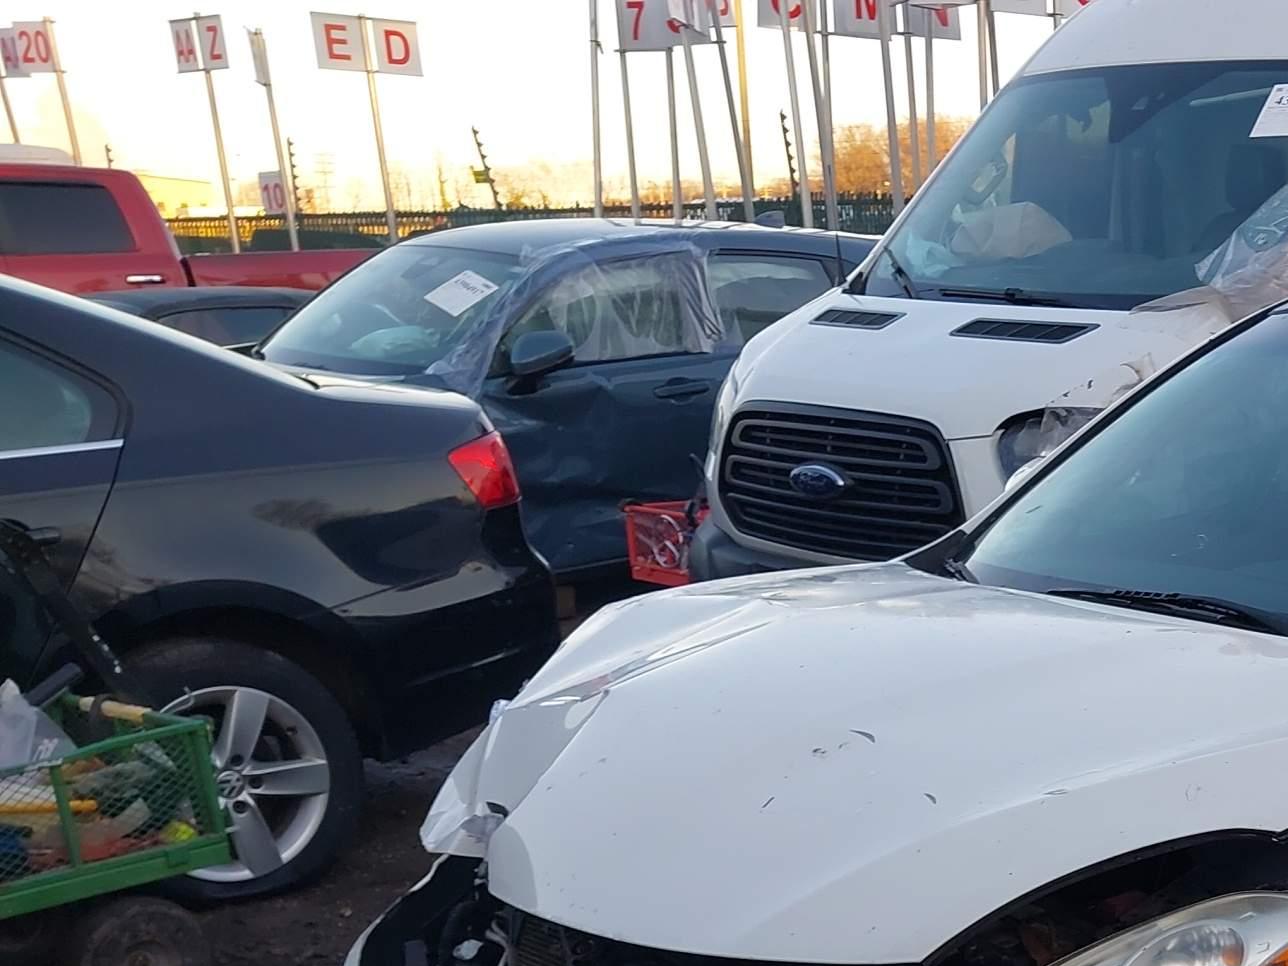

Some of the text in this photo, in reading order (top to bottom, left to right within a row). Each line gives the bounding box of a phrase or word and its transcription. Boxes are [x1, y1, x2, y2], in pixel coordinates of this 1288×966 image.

[626, 1, 645, 40] 7
[18, 30, 51, 64] 20
[206, 25, 223, 60] Z
[324, 23, 352, 61] E
[384, 29, 410, 64] D
[262, 182, 285, 209] 10
